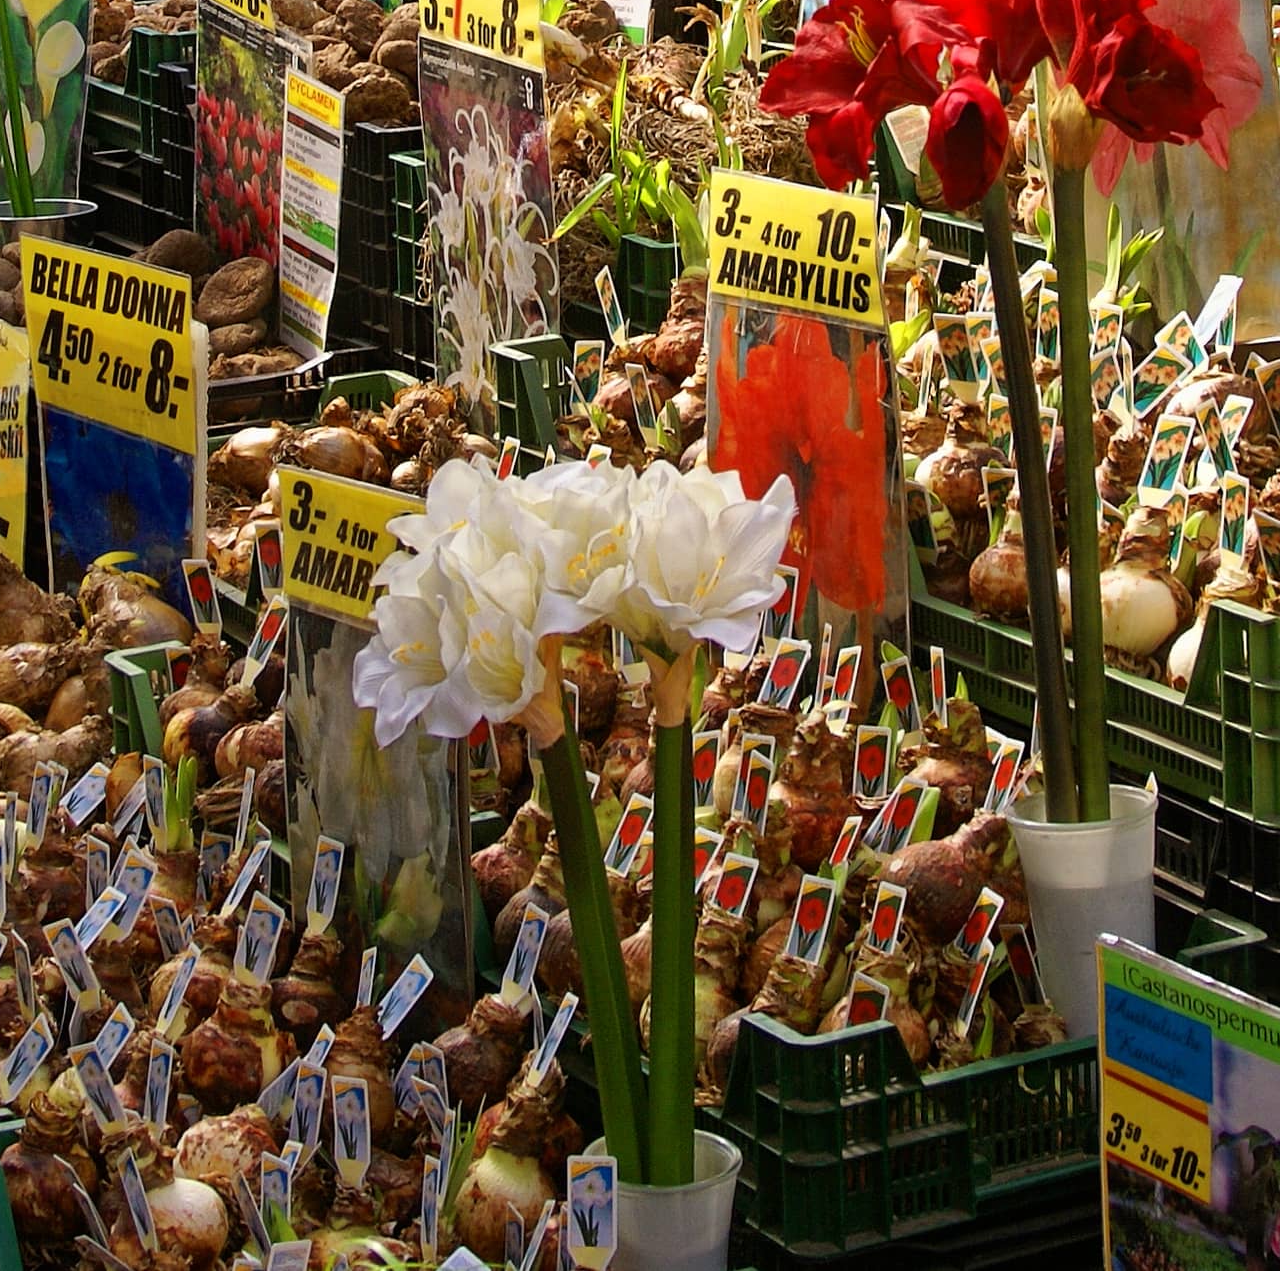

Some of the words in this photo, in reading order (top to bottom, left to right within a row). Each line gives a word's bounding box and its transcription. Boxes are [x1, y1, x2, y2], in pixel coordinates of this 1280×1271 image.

[478, 17, 497, 46] for
[289, 77, 337, 111] CYCLAMEN
[715, 188, 752, 240] 3.-
[774, 223, 801, 252] for
[817, 208, 872, 265] 10.-
[30, 251, 100, 310] BELLA
[102, 268, 188, 335] DONNA
[716, 247, 871, 314] AMARYLLIS
[37, 308, 94, 386] 4.50
[112, 354, 141, 392] for
[143, 339, 190, 420] 8.-
[288, 480, 326, 536] 3.-
[336, 519, 348, 543] 4
[349, 519, 379, 552] for
[1105, 1111, 1142, 1154] 3.50
